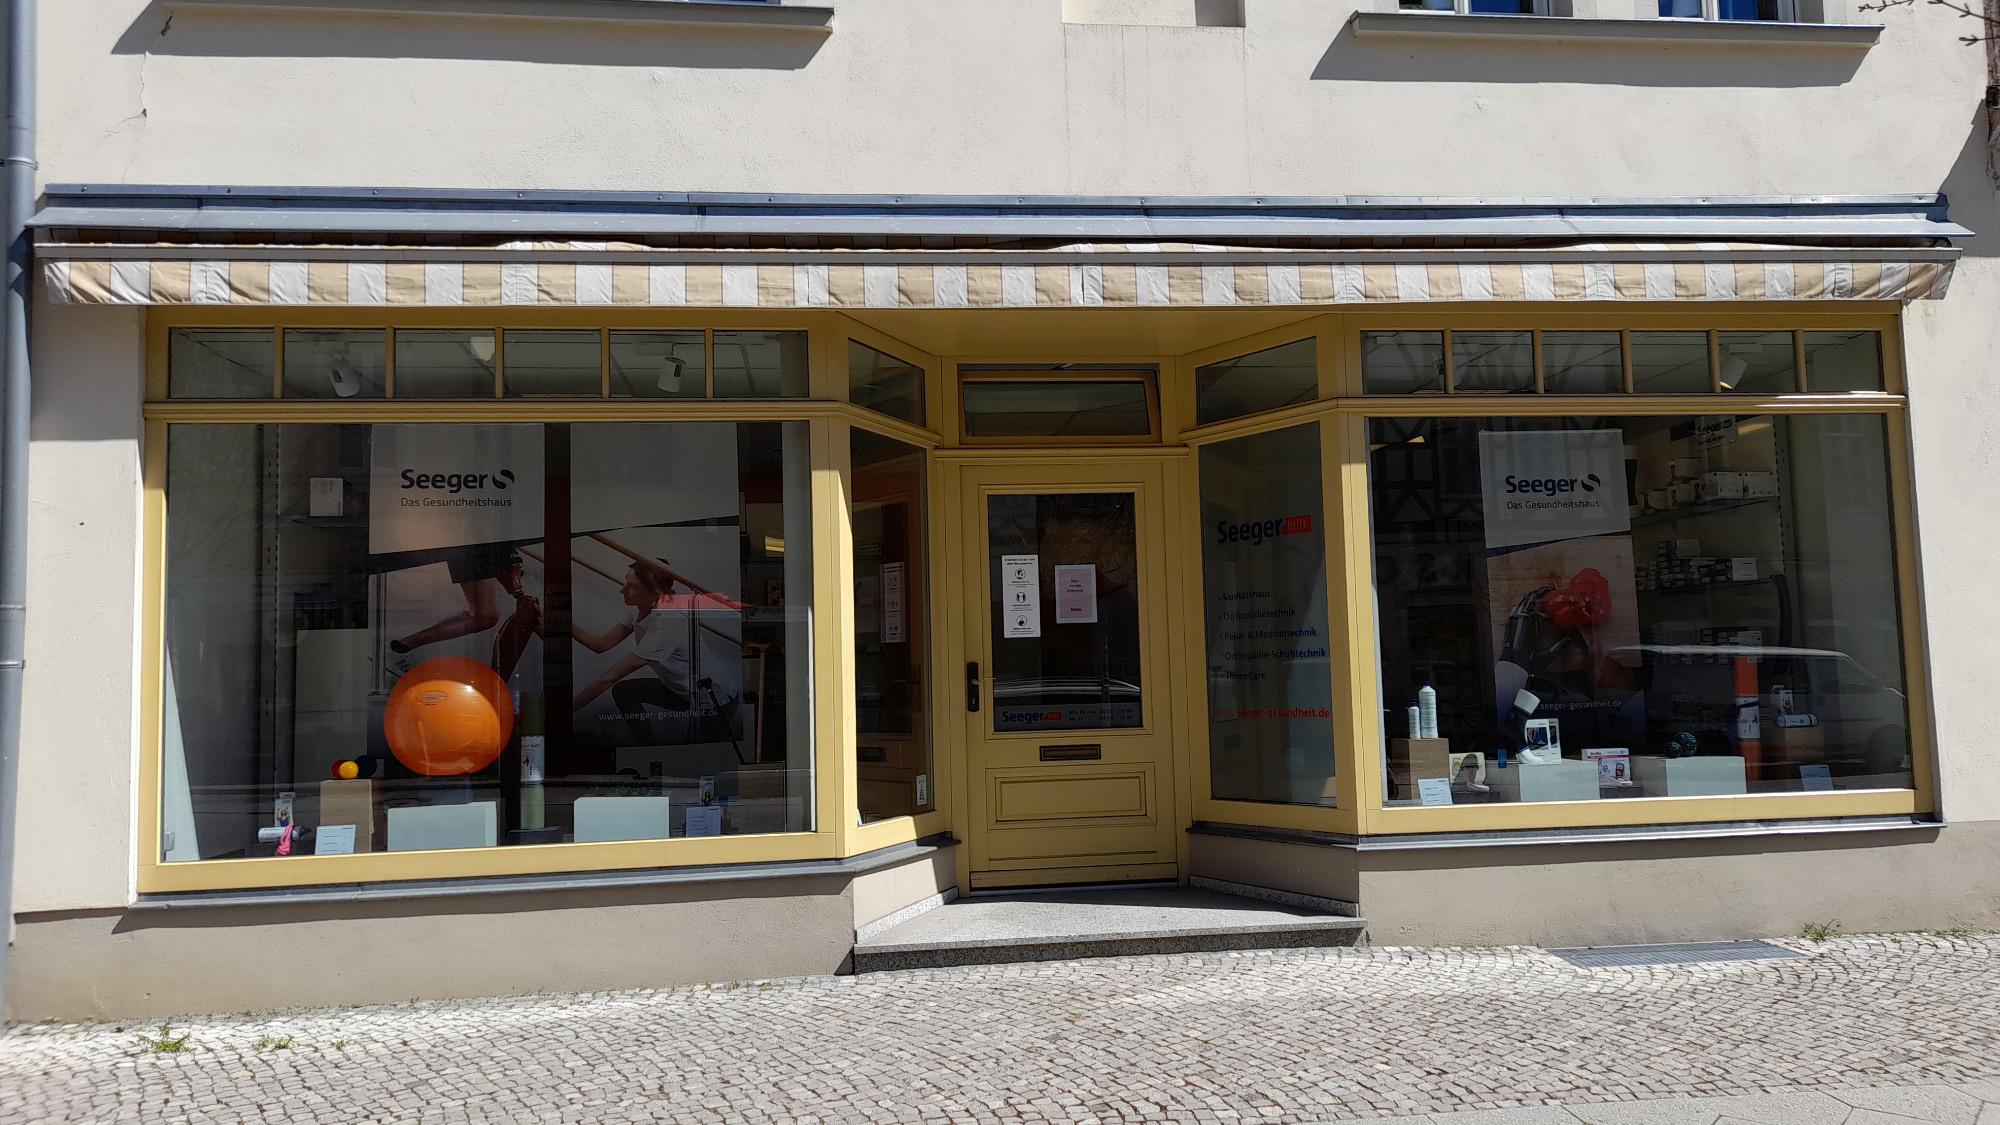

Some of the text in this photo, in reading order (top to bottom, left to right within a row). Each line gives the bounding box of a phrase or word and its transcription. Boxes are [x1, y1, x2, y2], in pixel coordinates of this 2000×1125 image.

[401, 468, 489, 494] Seeger
[1505, 475, 1578, 497] Seeger
[400, 497, 512, 507] Das Gesundheitshaus
[1507, 500, 1600, 510] Das Gesundheitshaus
[1217, 518, 1282, 546] Seeger
[1223, 608, 1296, 621] Orthopädietechnik
[1248, 631, 1254, 640] &
[1255, 627, 1317, 639] Medizintechnik
[1226, 647, 1326, 661] Orthopädie-Schuhtechnik
[1002, 710, 1044, 725] Seeger
